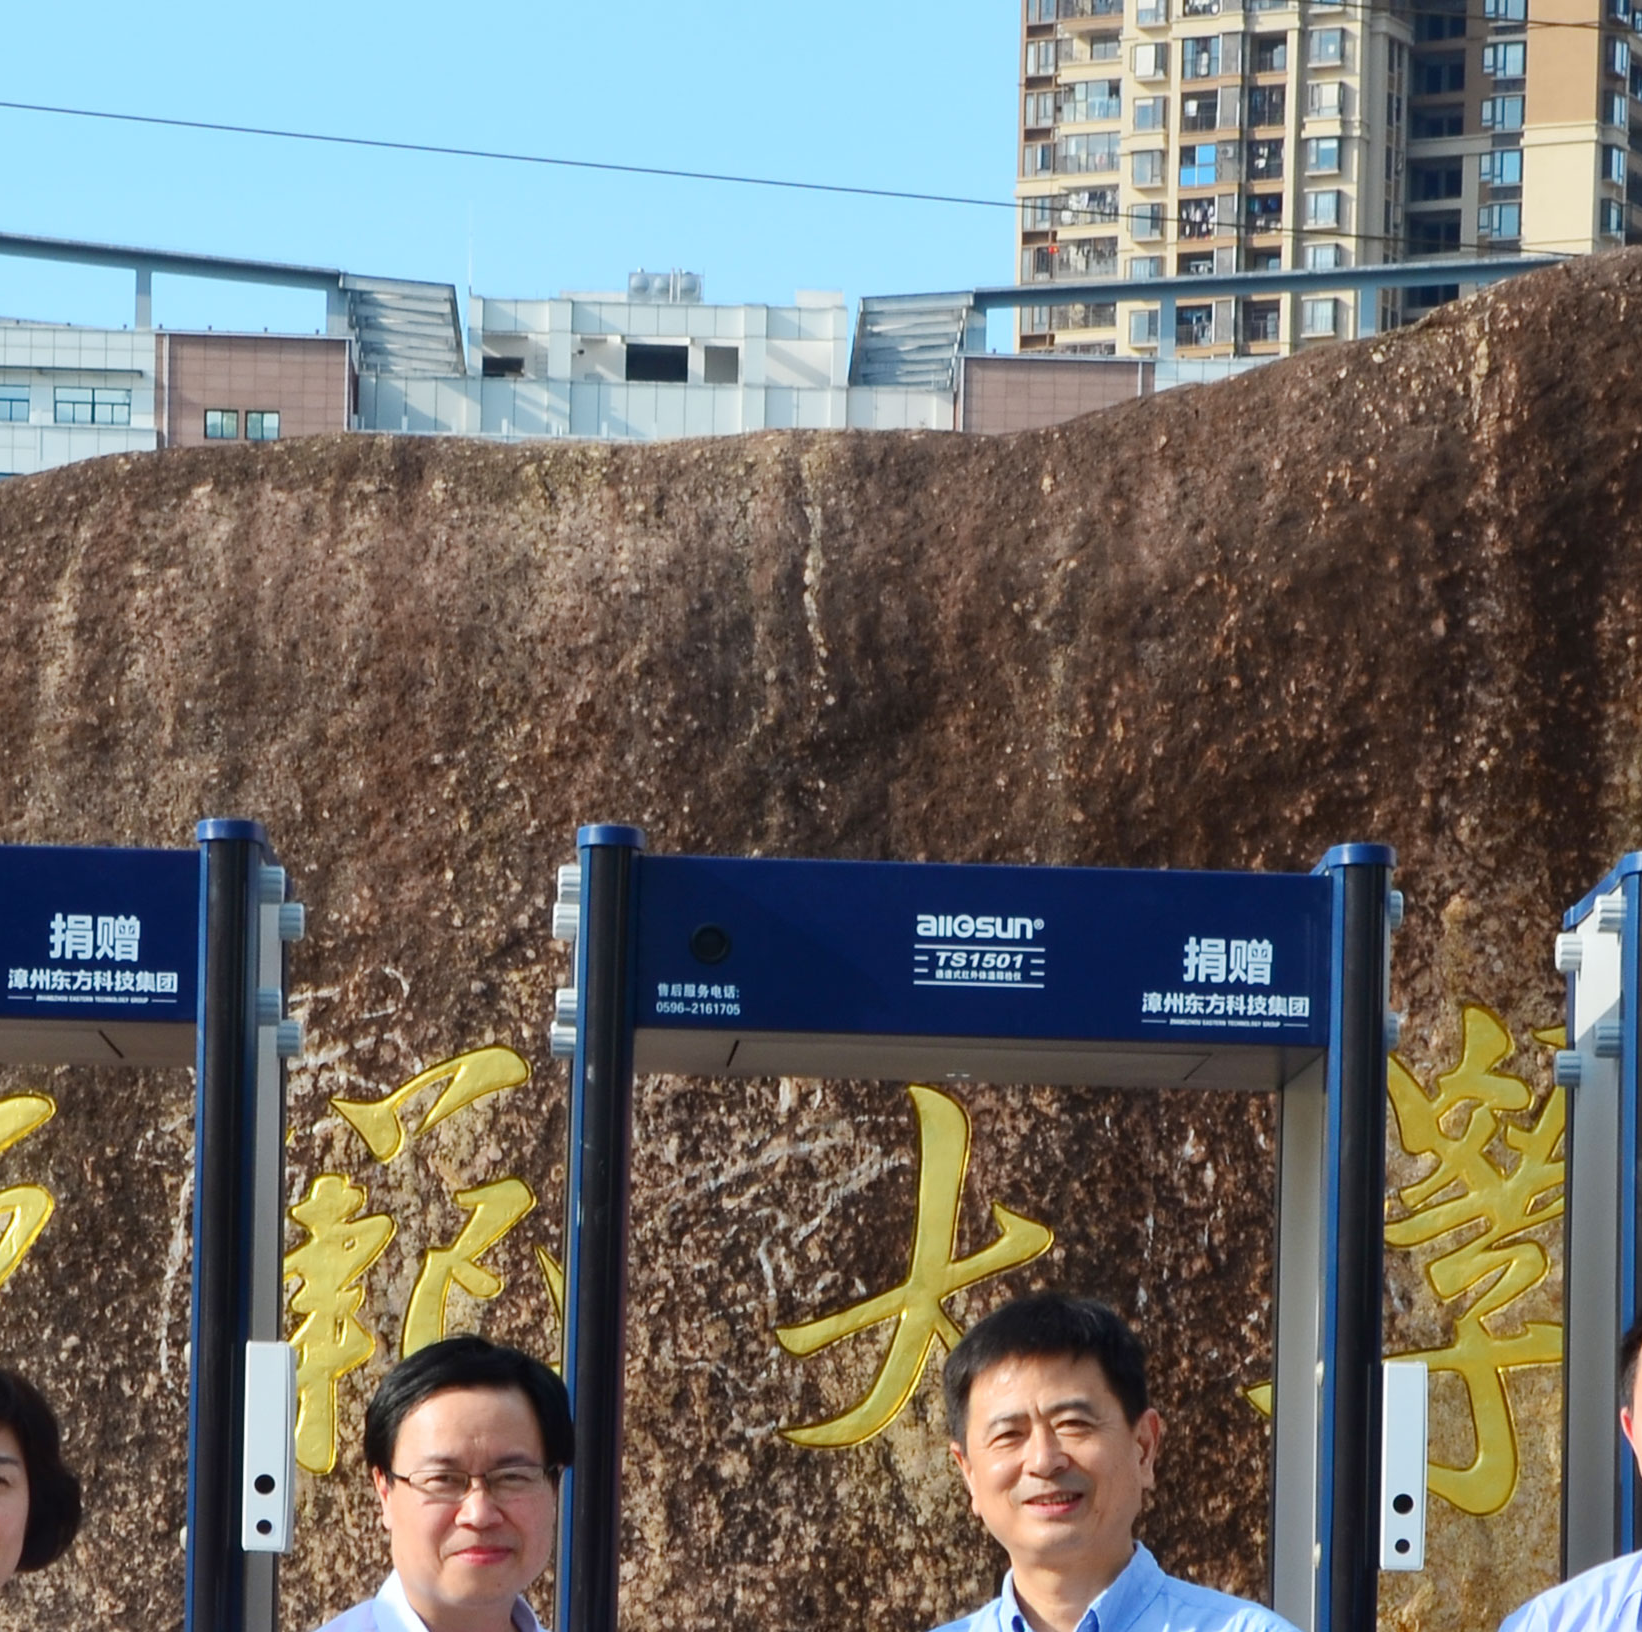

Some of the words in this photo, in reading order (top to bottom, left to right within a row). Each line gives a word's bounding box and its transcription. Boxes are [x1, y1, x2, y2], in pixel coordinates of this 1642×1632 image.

[50, 913, 140, 961] 捐赠
[936, 952, 1023, 968] TS1501
[1183, 937, 1272, 985] 捐赠
[8, 968, 178, 993] 漳州东方科技集团
[656, 1001, 740, 1015] 0596-2161705
[1142, 992, 1309, 1017] 漳州东方科技集团
